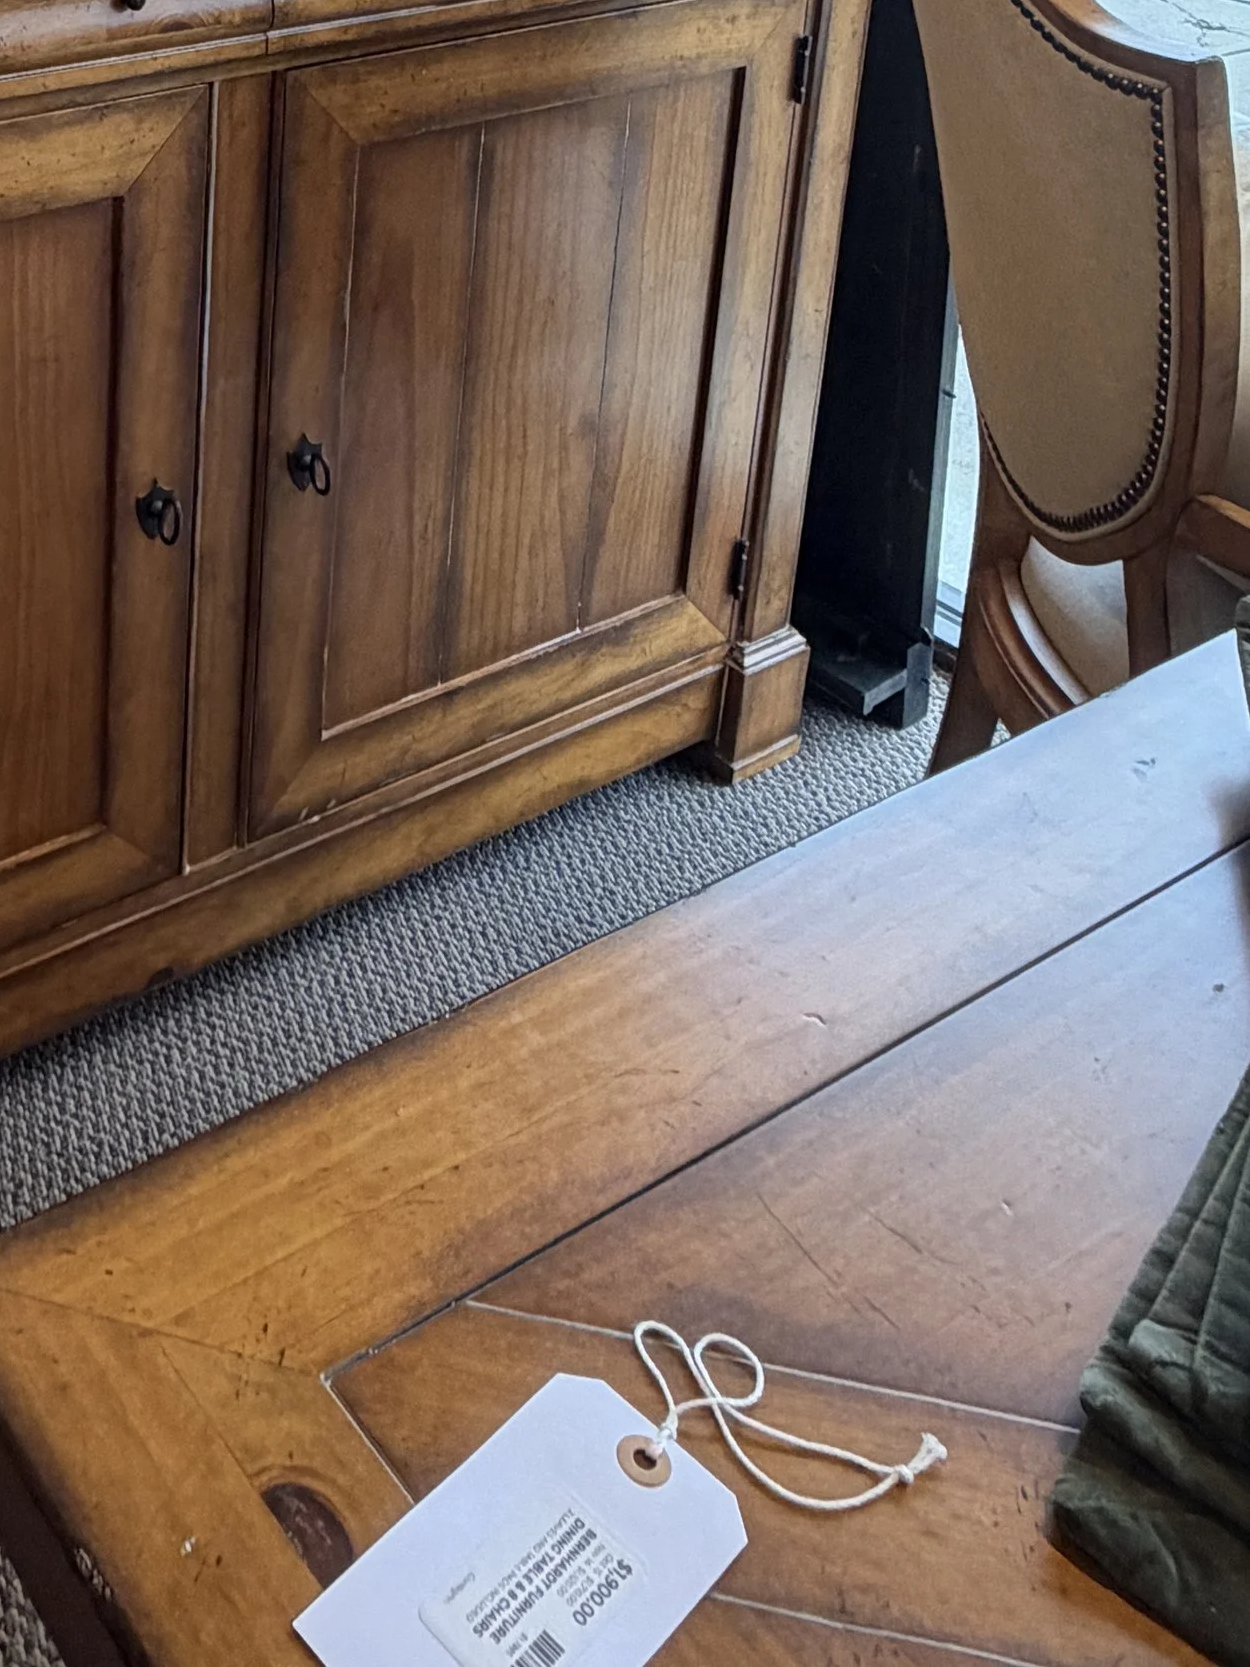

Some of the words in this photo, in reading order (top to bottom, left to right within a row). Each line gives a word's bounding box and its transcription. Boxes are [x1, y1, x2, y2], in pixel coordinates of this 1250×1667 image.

[548, 1516, 587, 1556] DINING
[519, 1549, 556, 1586] TABLE
[537, 1527, 598, 1591] BERNHARDT
[512, 1579, 528, 1593] &
[570, 1557, 635, 1627] $1,900.00
[470, 1596, 513, 1639] CHAIRS
[487, 1584, 546, 1645] FURNITURE
